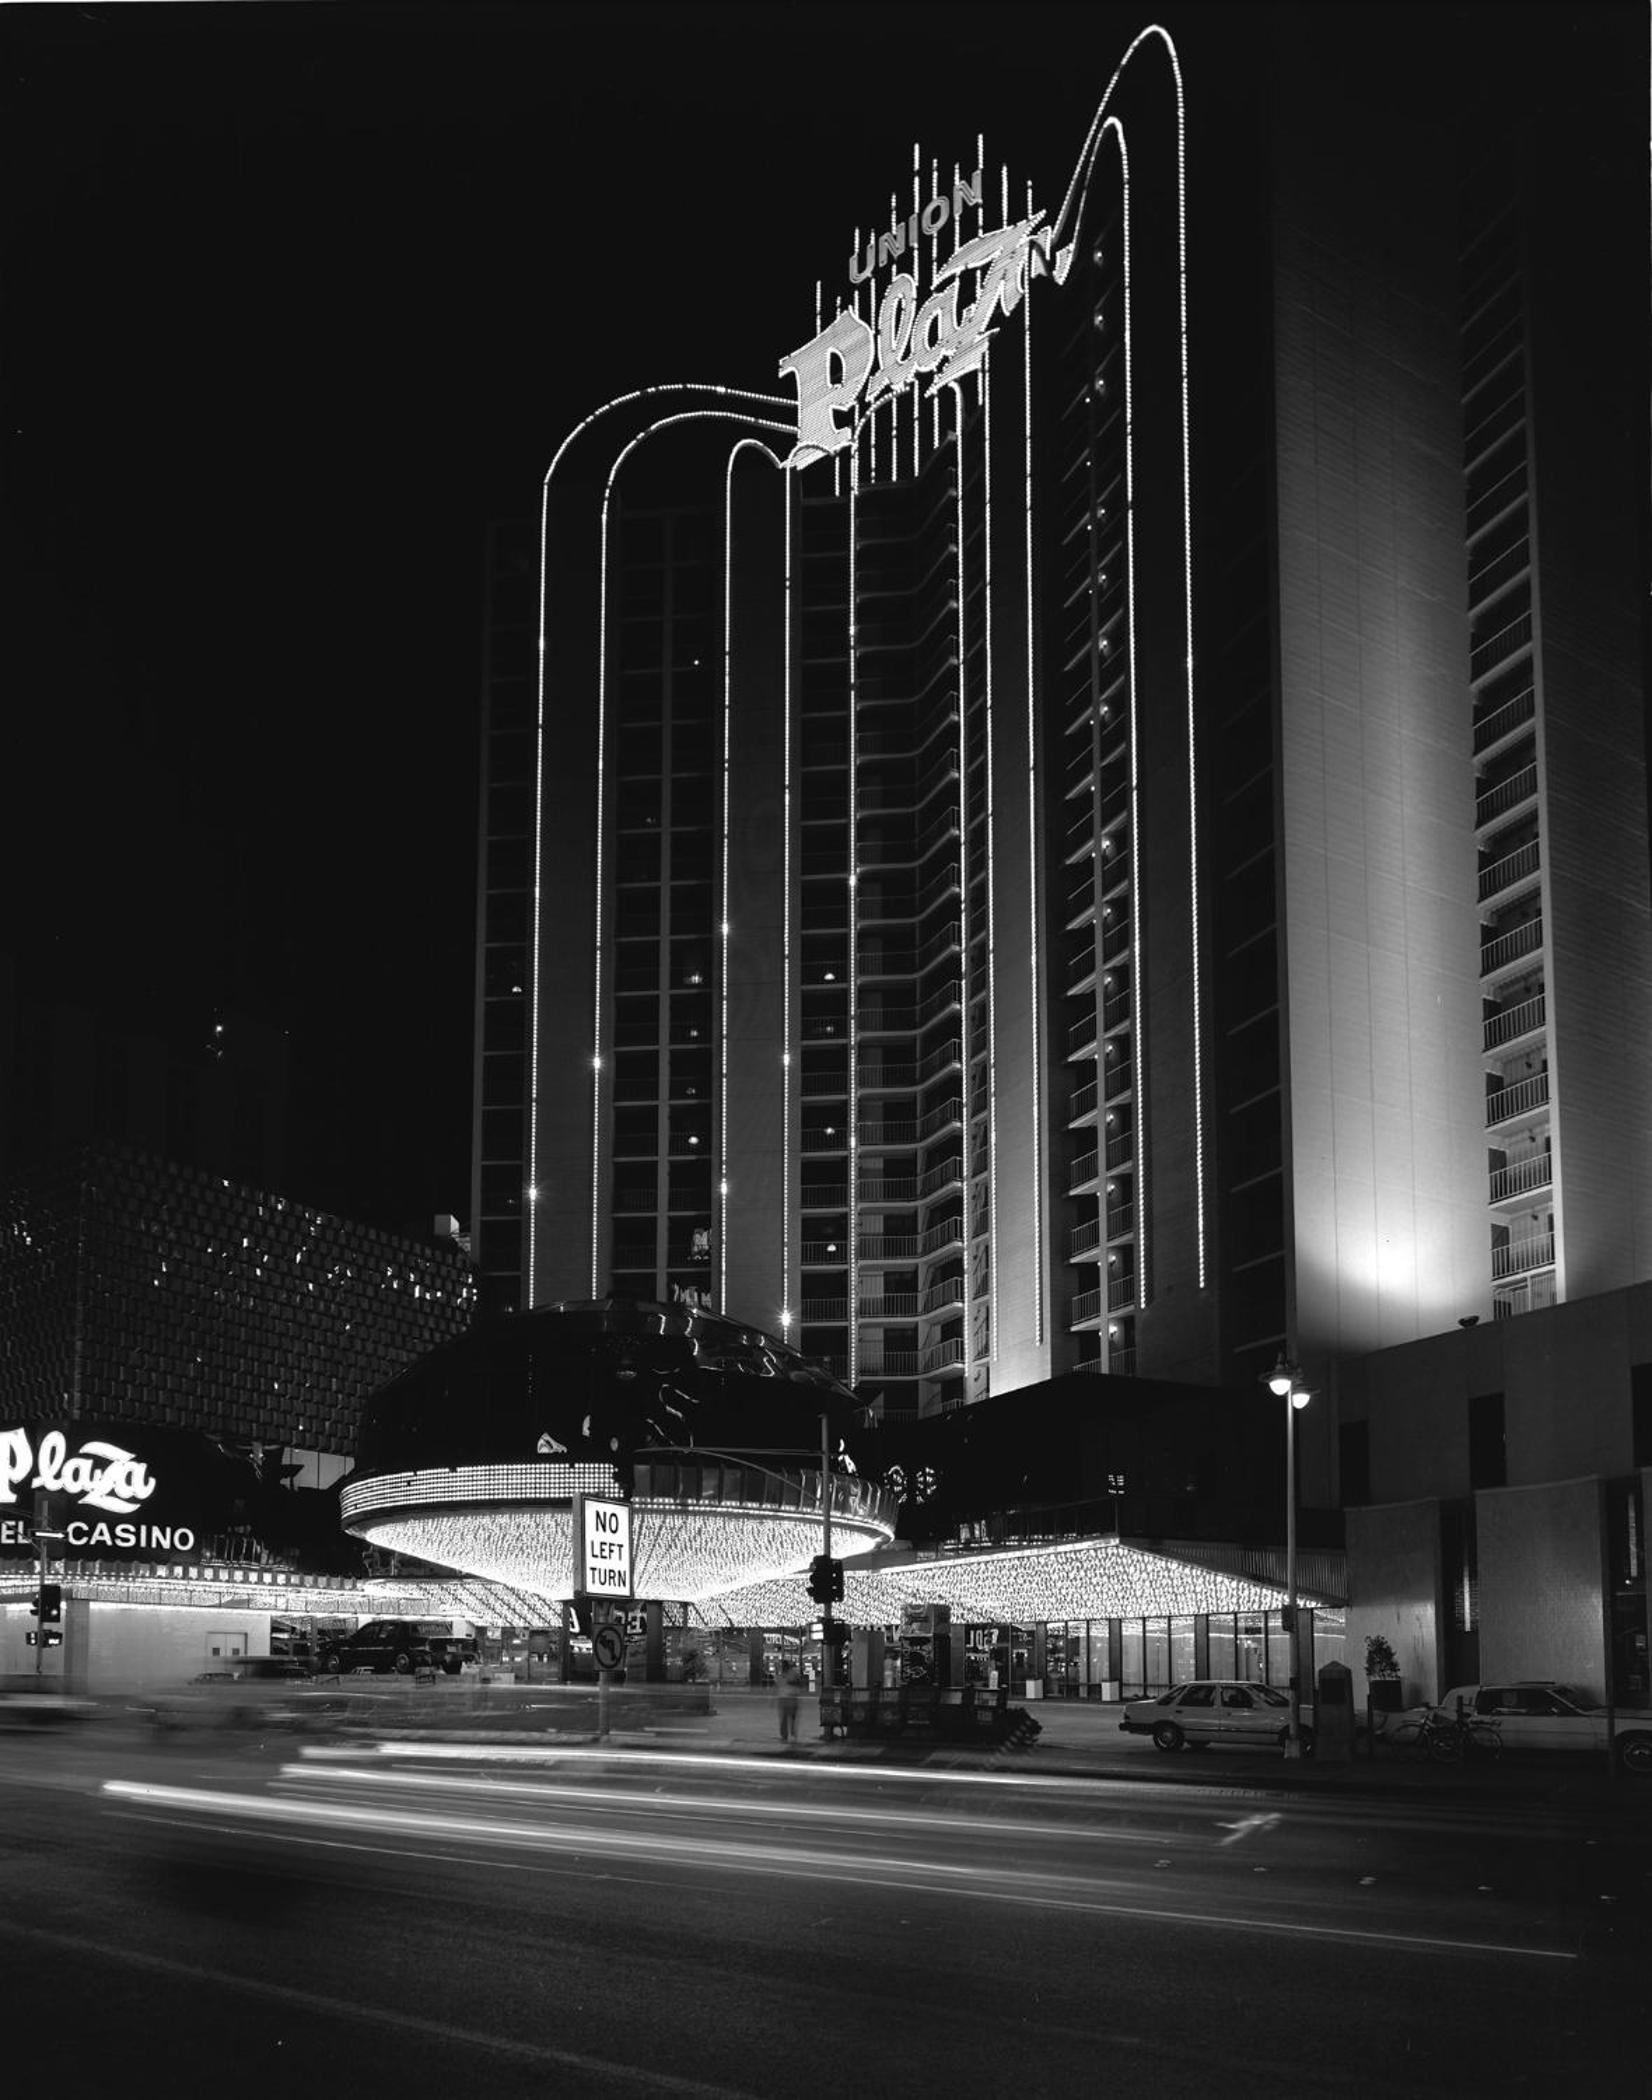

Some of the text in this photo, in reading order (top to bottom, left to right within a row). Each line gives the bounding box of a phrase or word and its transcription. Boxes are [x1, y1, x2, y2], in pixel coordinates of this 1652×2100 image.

[849, 169, 983, 284] UNION
[778, 209, 1074, 470] Plaza
[595, 1510, 619, 1534] NO
[66, 1521, 196, 1551] CASINO
[590, 1541, 623, 1562] LEFT
[589, 1567, 627, 1588] TURN
